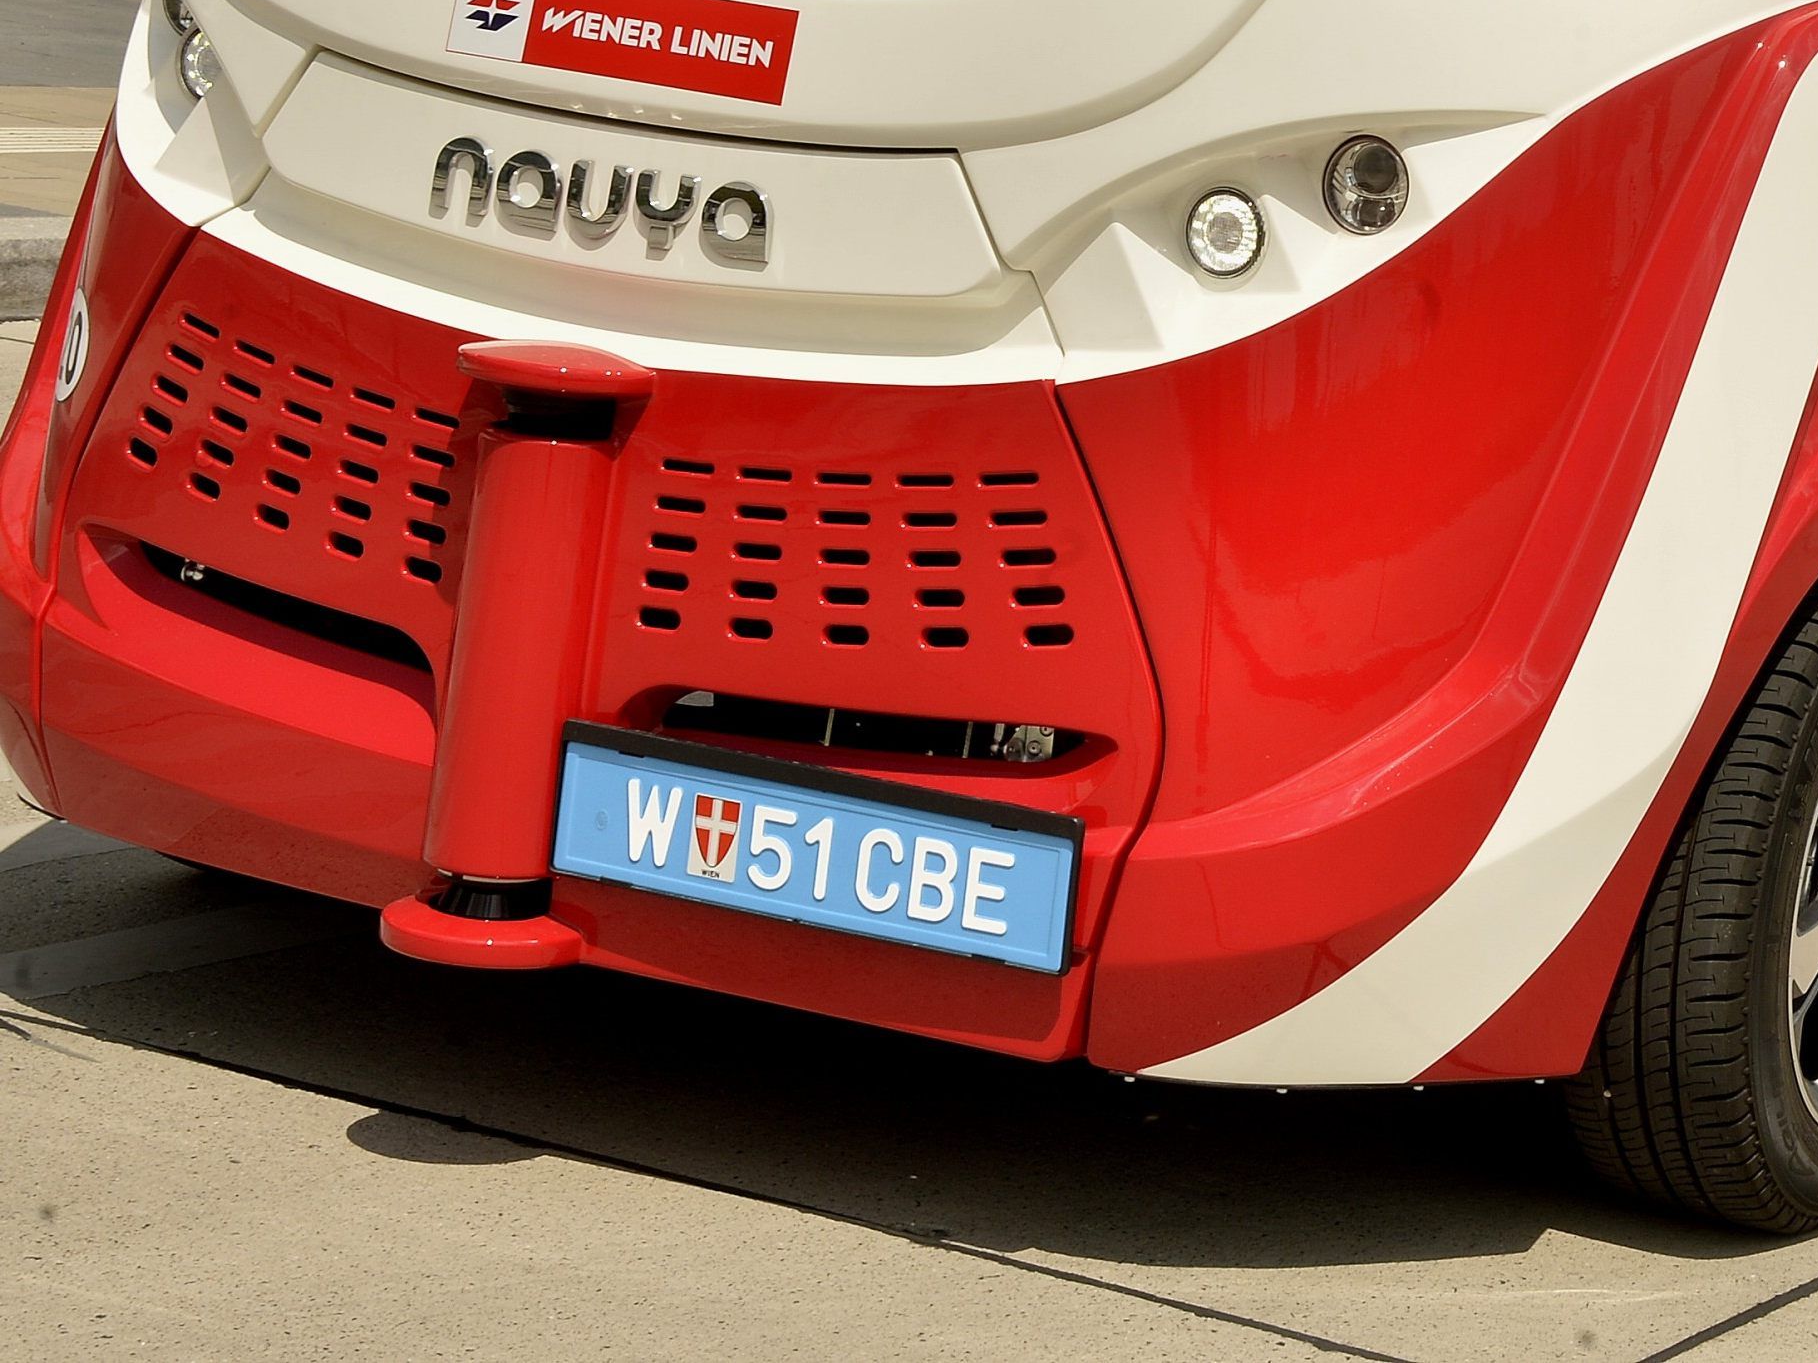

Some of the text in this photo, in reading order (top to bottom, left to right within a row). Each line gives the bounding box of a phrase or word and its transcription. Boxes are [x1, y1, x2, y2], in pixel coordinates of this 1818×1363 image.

[542, 7, 774, 68] WIENER LINIEN
[60, 311, 82, 385] 0
[627, 778, 1015, 935] W 51 CBE
